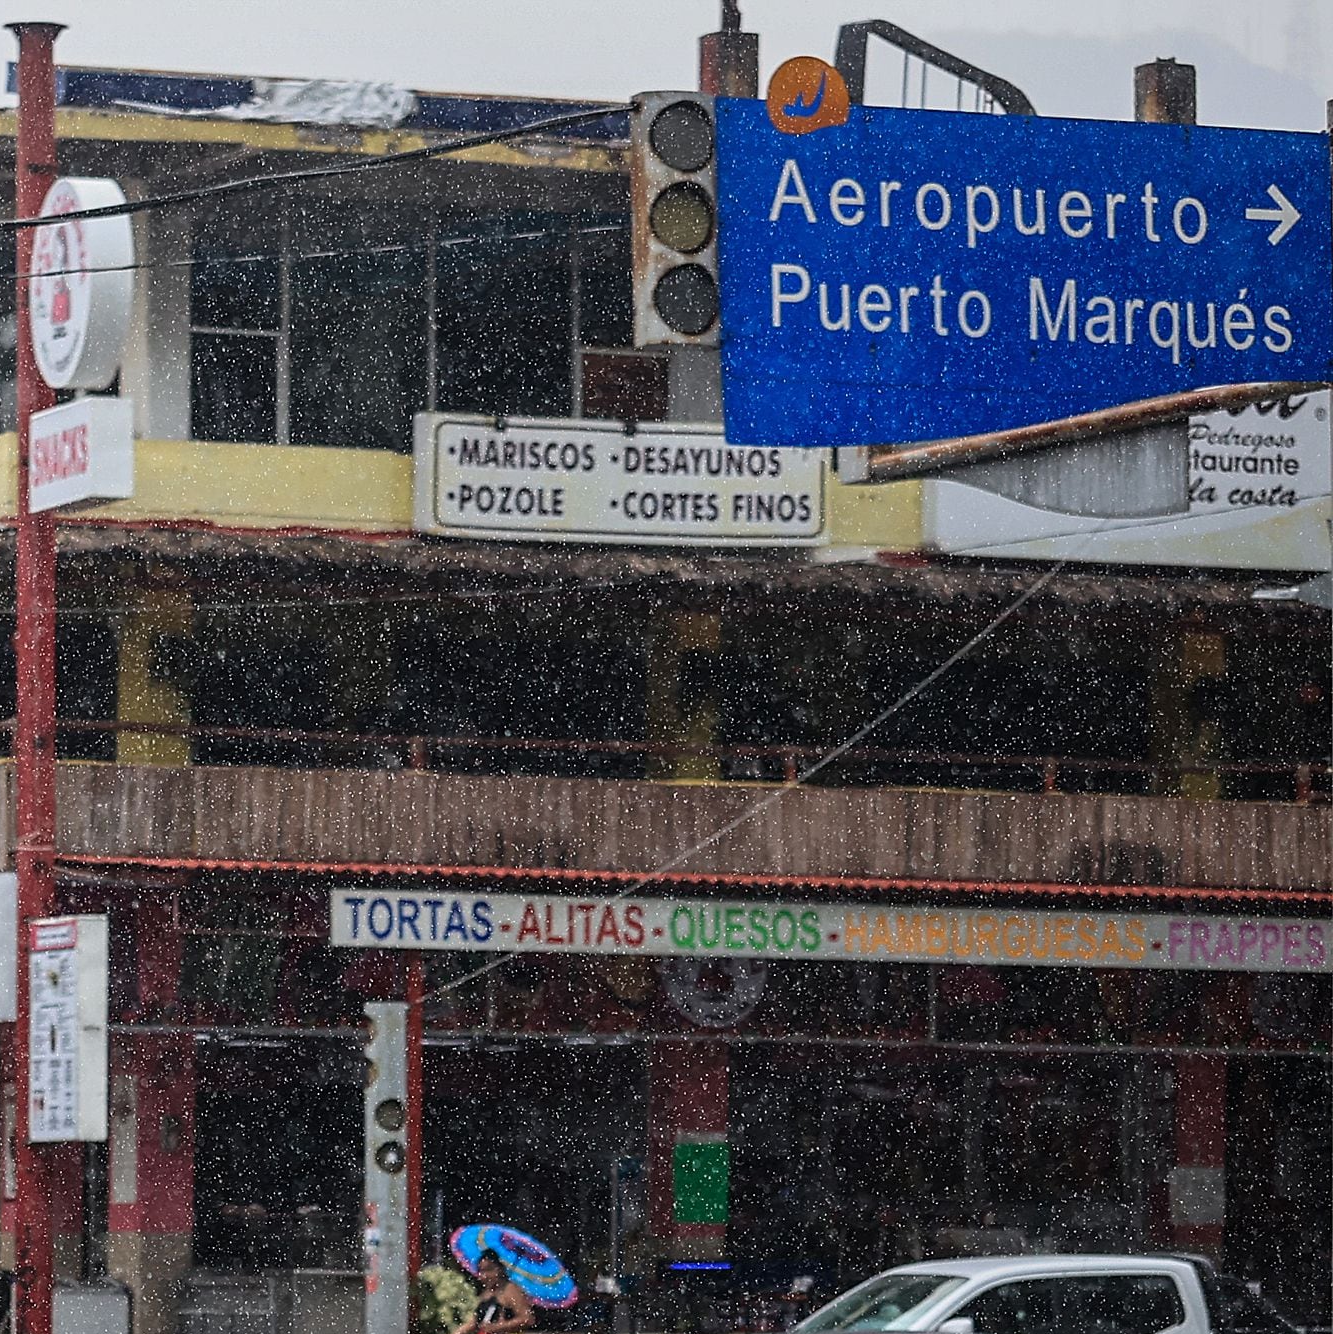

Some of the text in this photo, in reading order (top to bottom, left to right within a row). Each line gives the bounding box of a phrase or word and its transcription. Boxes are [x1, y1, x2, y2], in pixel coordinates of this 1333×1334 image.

[769, 159, 1208, 248] Aeropuerto
[770, 264, 1294, 365] Puerto Marqués
[459, 438, 782, 478] MARISCOS DESAYUNOS
[1190, 449, 1300, 476] taurante
[459, 484, 812, 523] POZOLE CORTES FINOS
[1227, 484, 1300, 507] costa
[344, 897, 1326, 966] TORTAS ALITAS QUESOS HAMBURGUESAS FRAPPES
